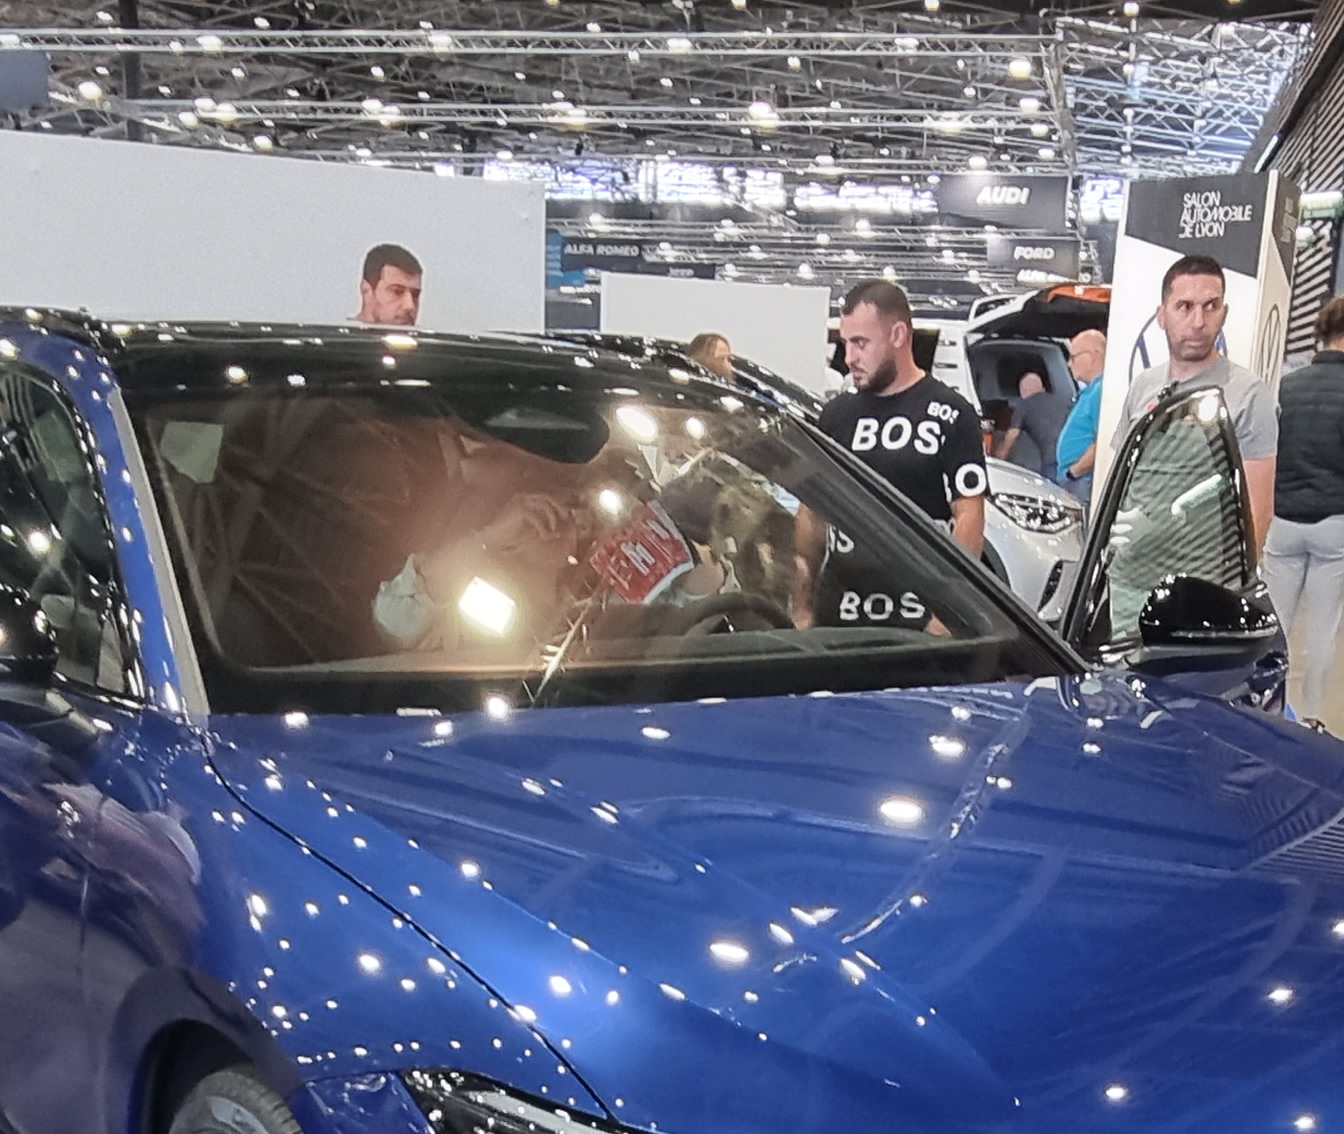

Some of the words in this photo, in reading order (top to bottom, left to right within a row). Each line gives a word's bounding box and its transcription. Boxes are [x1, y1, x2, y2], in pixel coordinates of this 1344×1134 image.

[976, 185, 1030, 206] AUDI
[1183, 190, 1221, 208] SALON
[1195, 221, 1225, 238] LYON
[564, 243, 594, 255] ALFA
[596, 243, 640, 257] ROMEO
[1013, 246, 1055, 260] FORD
[851, 416, 946, 455] BOS
